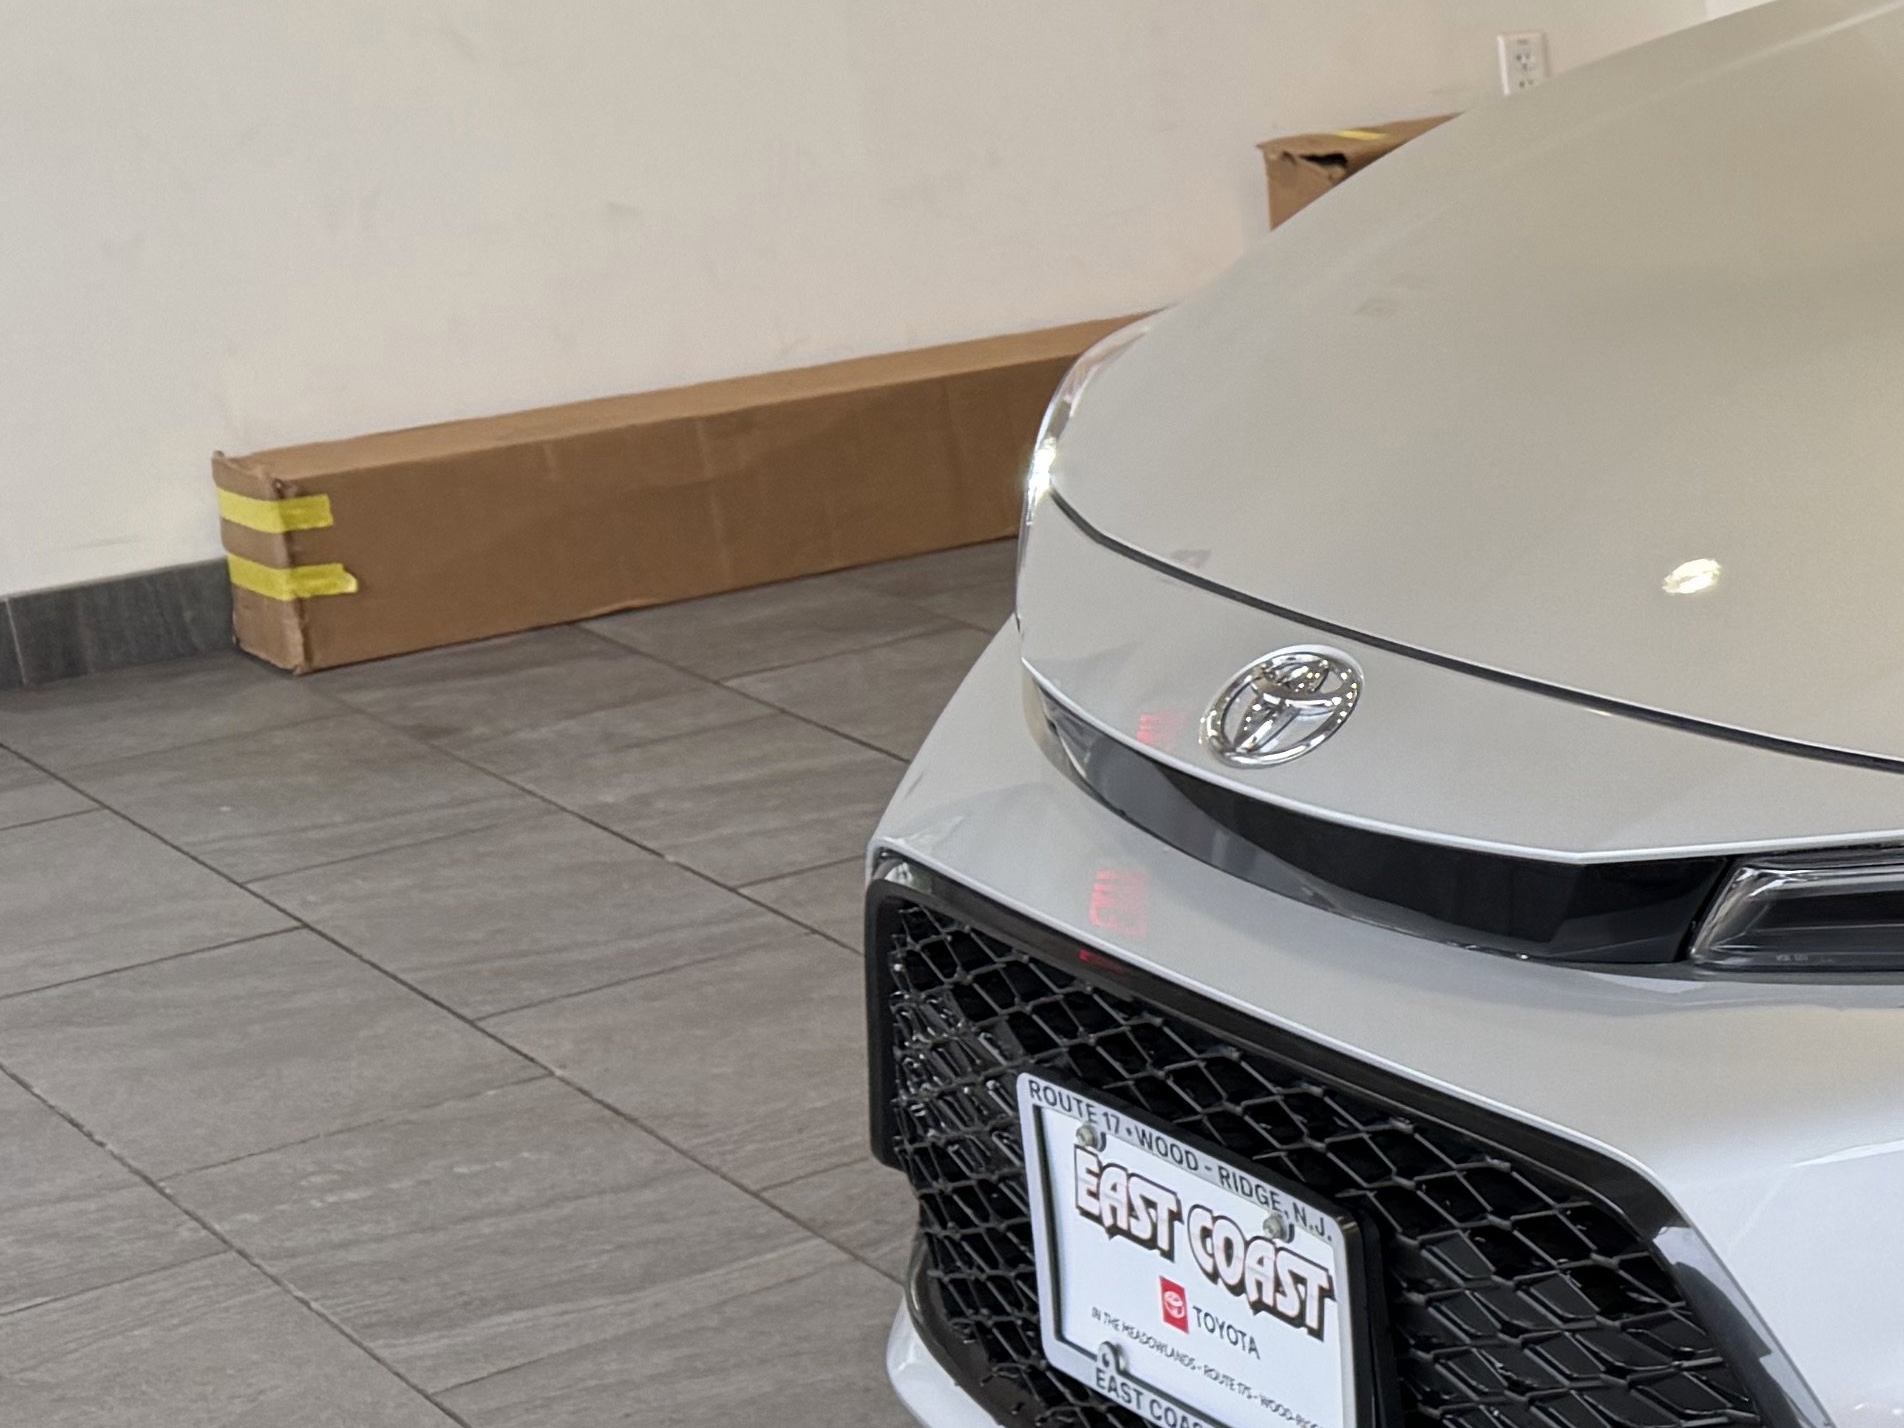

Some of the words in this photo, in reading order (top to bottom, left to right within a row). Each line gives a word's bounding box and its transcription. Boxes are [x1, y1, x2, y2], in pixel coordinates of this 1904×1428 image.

[1028, 1079, 1097, 1123] ROUTE
[1102, 1111, 1121, 1134] 17
[1135, 1126, 1199, 1172] WOOD
[1218, 1164, 1289, 1219] RIDGE,
[1293, 1207, 1333, 1243] N.J.
[1073, 1144, 1184, 1263] EAST
[1186, 1202, 1337, 1342] COAST
[1192, 1304, 1261, 1360] TOYOTA
[1095, 1367, 1144, 1411] EAST
